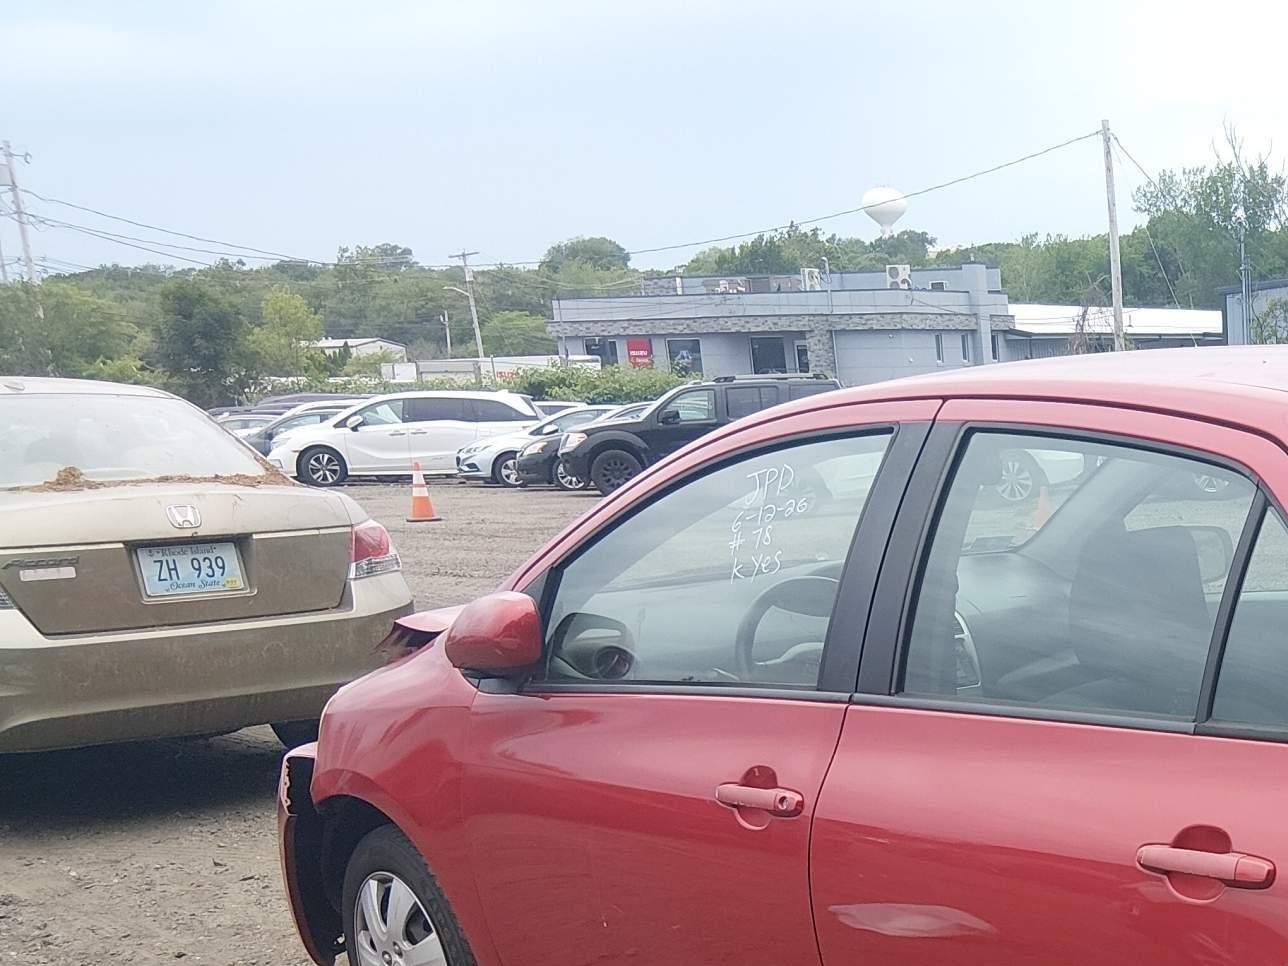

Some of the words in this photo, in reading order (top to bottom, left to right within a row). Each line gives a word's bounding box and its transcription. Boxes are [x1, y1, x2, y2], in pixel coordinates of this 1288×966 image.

[731, 497, 808, 533] 6-12-26
[161, 547, 187, 557] Rhode
[190, 546, 216, 555] Island
[153, 558, 180, 582] ZH
[190, 556, 226, 578] 939
[170, 580, 196, 590] Ocean
[198, 579, 220, 589] State
